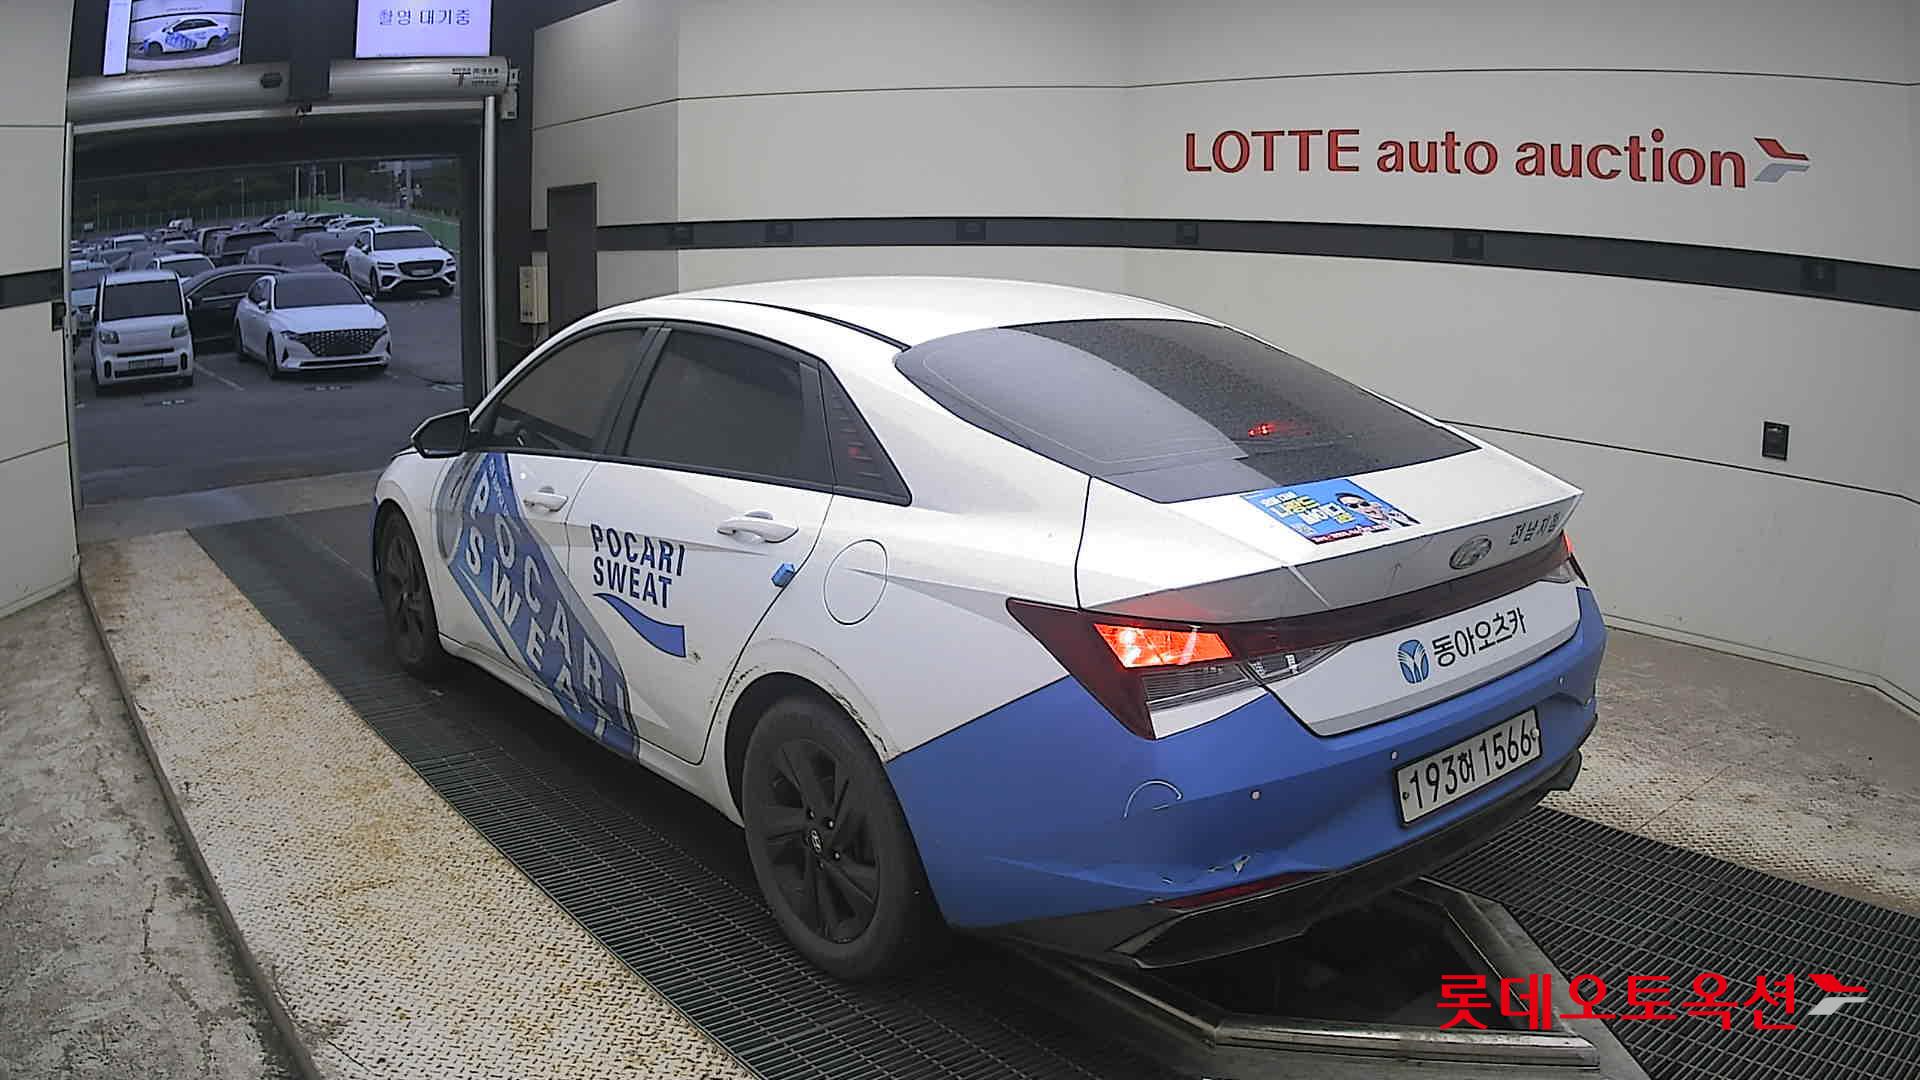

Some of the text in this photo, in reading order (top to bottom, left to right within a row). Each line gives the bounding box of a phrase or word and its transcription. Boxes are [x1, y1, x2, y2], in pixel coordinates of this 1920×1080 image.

[419, 8, 470, 26] 대기중
[1186, 128, 1746, 188] LOTTE auto auction
[591, 524, 685, 577] POCARI
[593, 556, 673, 608] SWEAT
[1432, 607, 1526, 667] 동아오츠카
[1479, 720, 1532, 777] 1566
